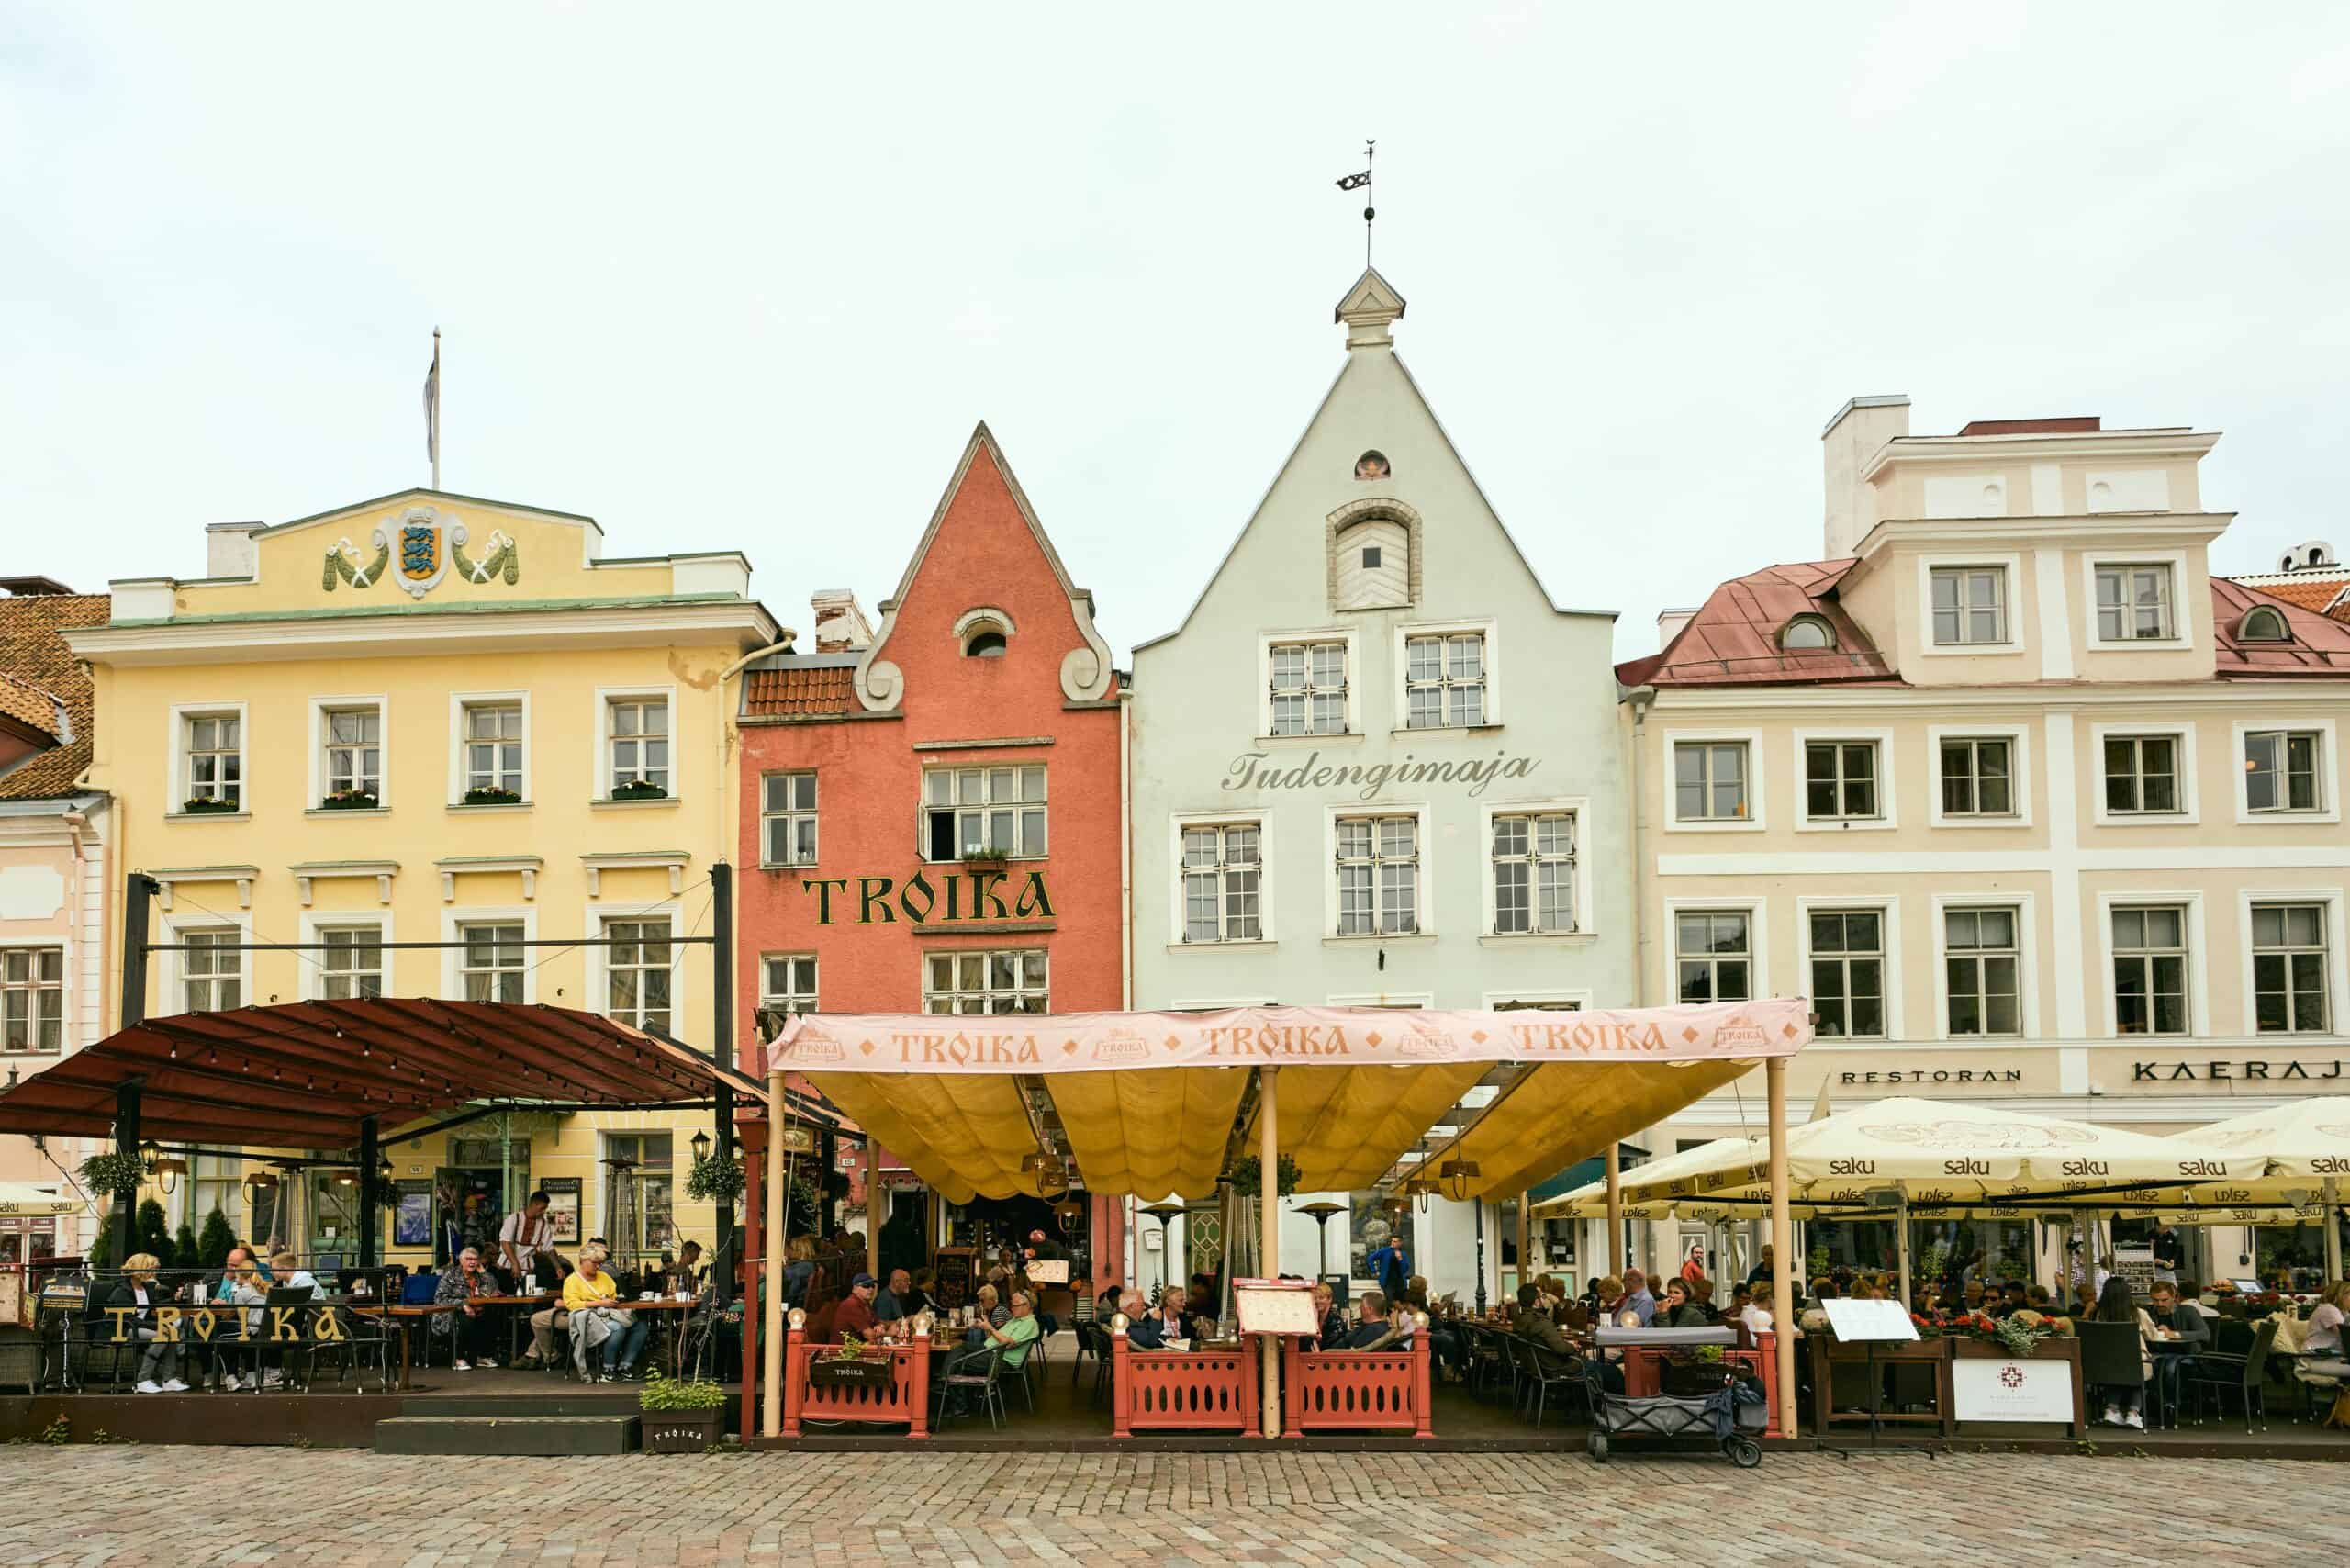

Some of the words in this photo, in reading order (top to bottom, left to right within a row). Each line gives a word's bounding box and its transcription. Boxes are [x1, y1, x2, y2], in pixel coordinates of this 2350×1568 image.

[1221, 749, 1542, 801] Tudengimaja
[801, 868, 1058, 925] TROIKA
[891, 1031, 1043, 1066] TROIKA
[1201, 1023, 1351, 1057] TROIKA
[1512, 1021, 1670, 1053] TROIKA
[1841, 1070, 2020, 1083] RESTORAN
[2134, 1060, 2341, 1080] KAERAJ
[1830, 1157, 1875, 1175] saku
[1944, 1157, 1990, 1175] saku
[2062, 1158, 2109, 1176] saku
[2178, 1159, 2227, 1176] saku
[51, 1201, 73, 1212] saku
[104, 1306, 344, 1342] TROIKA
[653, 1428, 702, 1440] TROIKA
